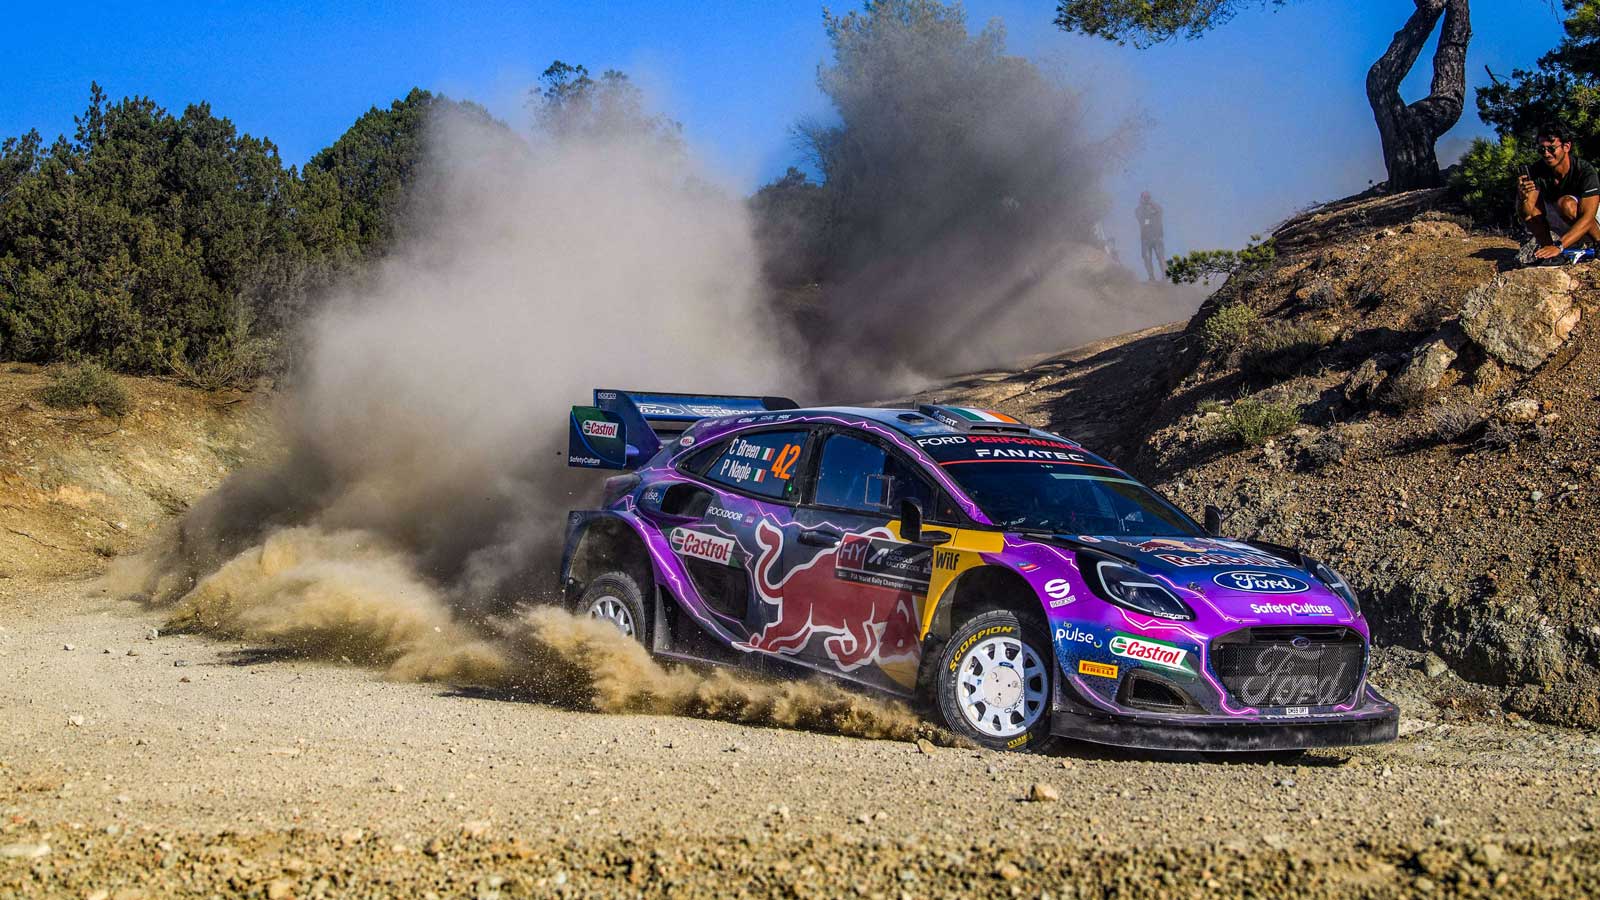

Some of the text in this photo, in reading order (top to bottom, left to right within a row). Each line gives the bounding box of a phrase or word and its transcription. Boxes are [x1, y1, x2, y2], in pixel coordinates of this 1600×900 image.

[591, 423, 616, 436] Castrol
[729, 438, 760, 459] C Breen
[917, 436, 966, 448] FORD
[569, 456, 600, 464] SafetyCulture
[771, 443, 801, 480] 42
[975, 449, 1085, 462] FANATEC
[720, 459, 752, 483] P Nagle
[707, 506, 742, 521] ROCKDOOR
[684, 533, 730, 561] Castrol
[936, 551, 960, 570] Wilf
[1231, 573, 1296, 591] Ford
[1251, 603, 1332, 616] SafetyCulture
[1055, 627, 1094, 644] pulse
[949, 626, 1014, 672] SCORPION
[1127, 641, 1181, 664] Castrol
[1241, 646, 1347, 705] Ford
